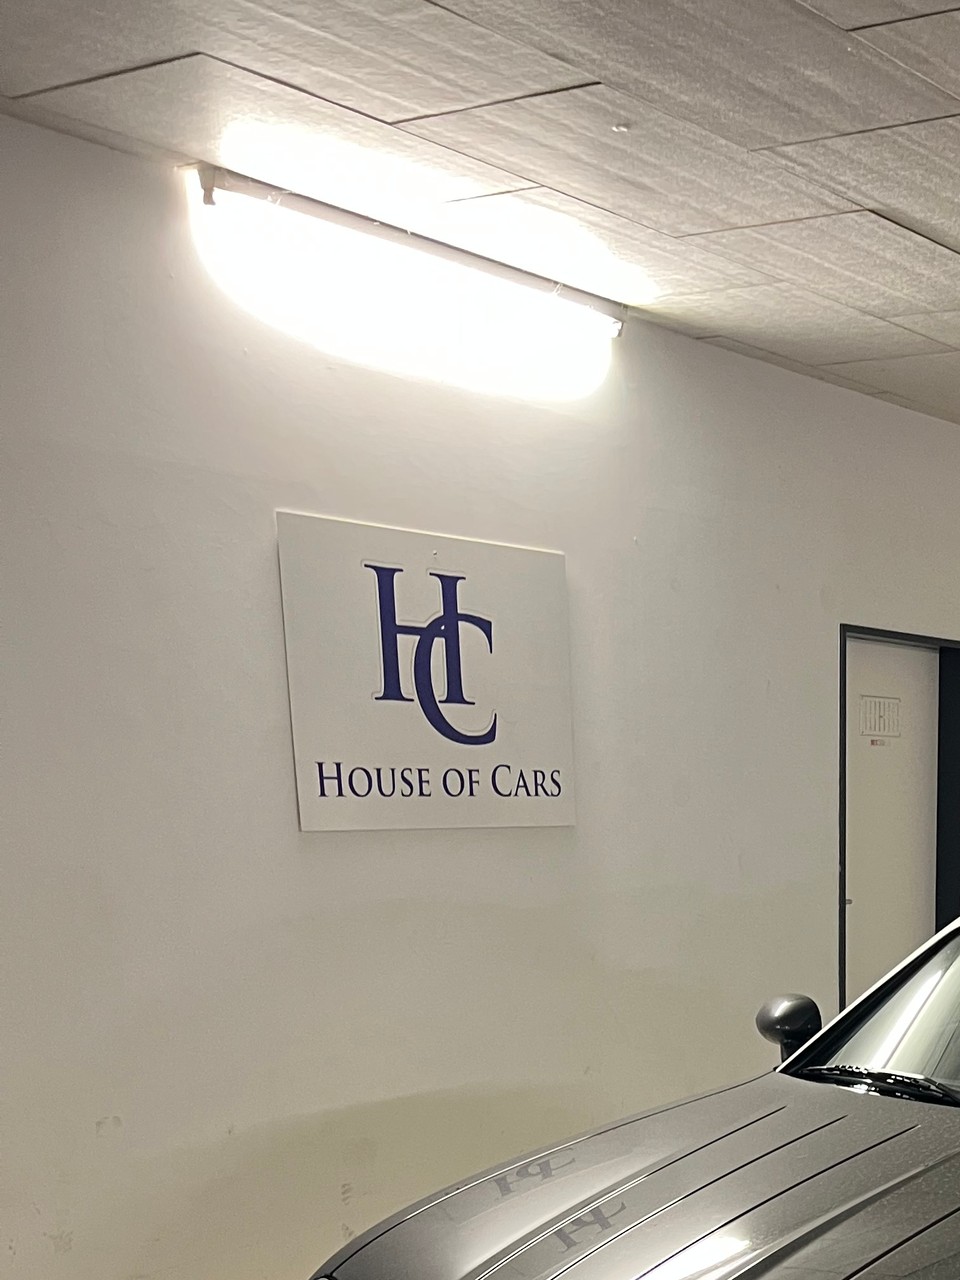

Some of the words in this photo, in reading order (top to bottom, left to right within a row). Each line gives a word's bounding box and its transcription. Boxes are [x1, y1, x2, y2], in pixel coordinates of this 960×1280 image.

[315, 761, 433, 798] HOUSE
[442, 767, 480, 798] OF
[491, 764, 562, 798] CARS
